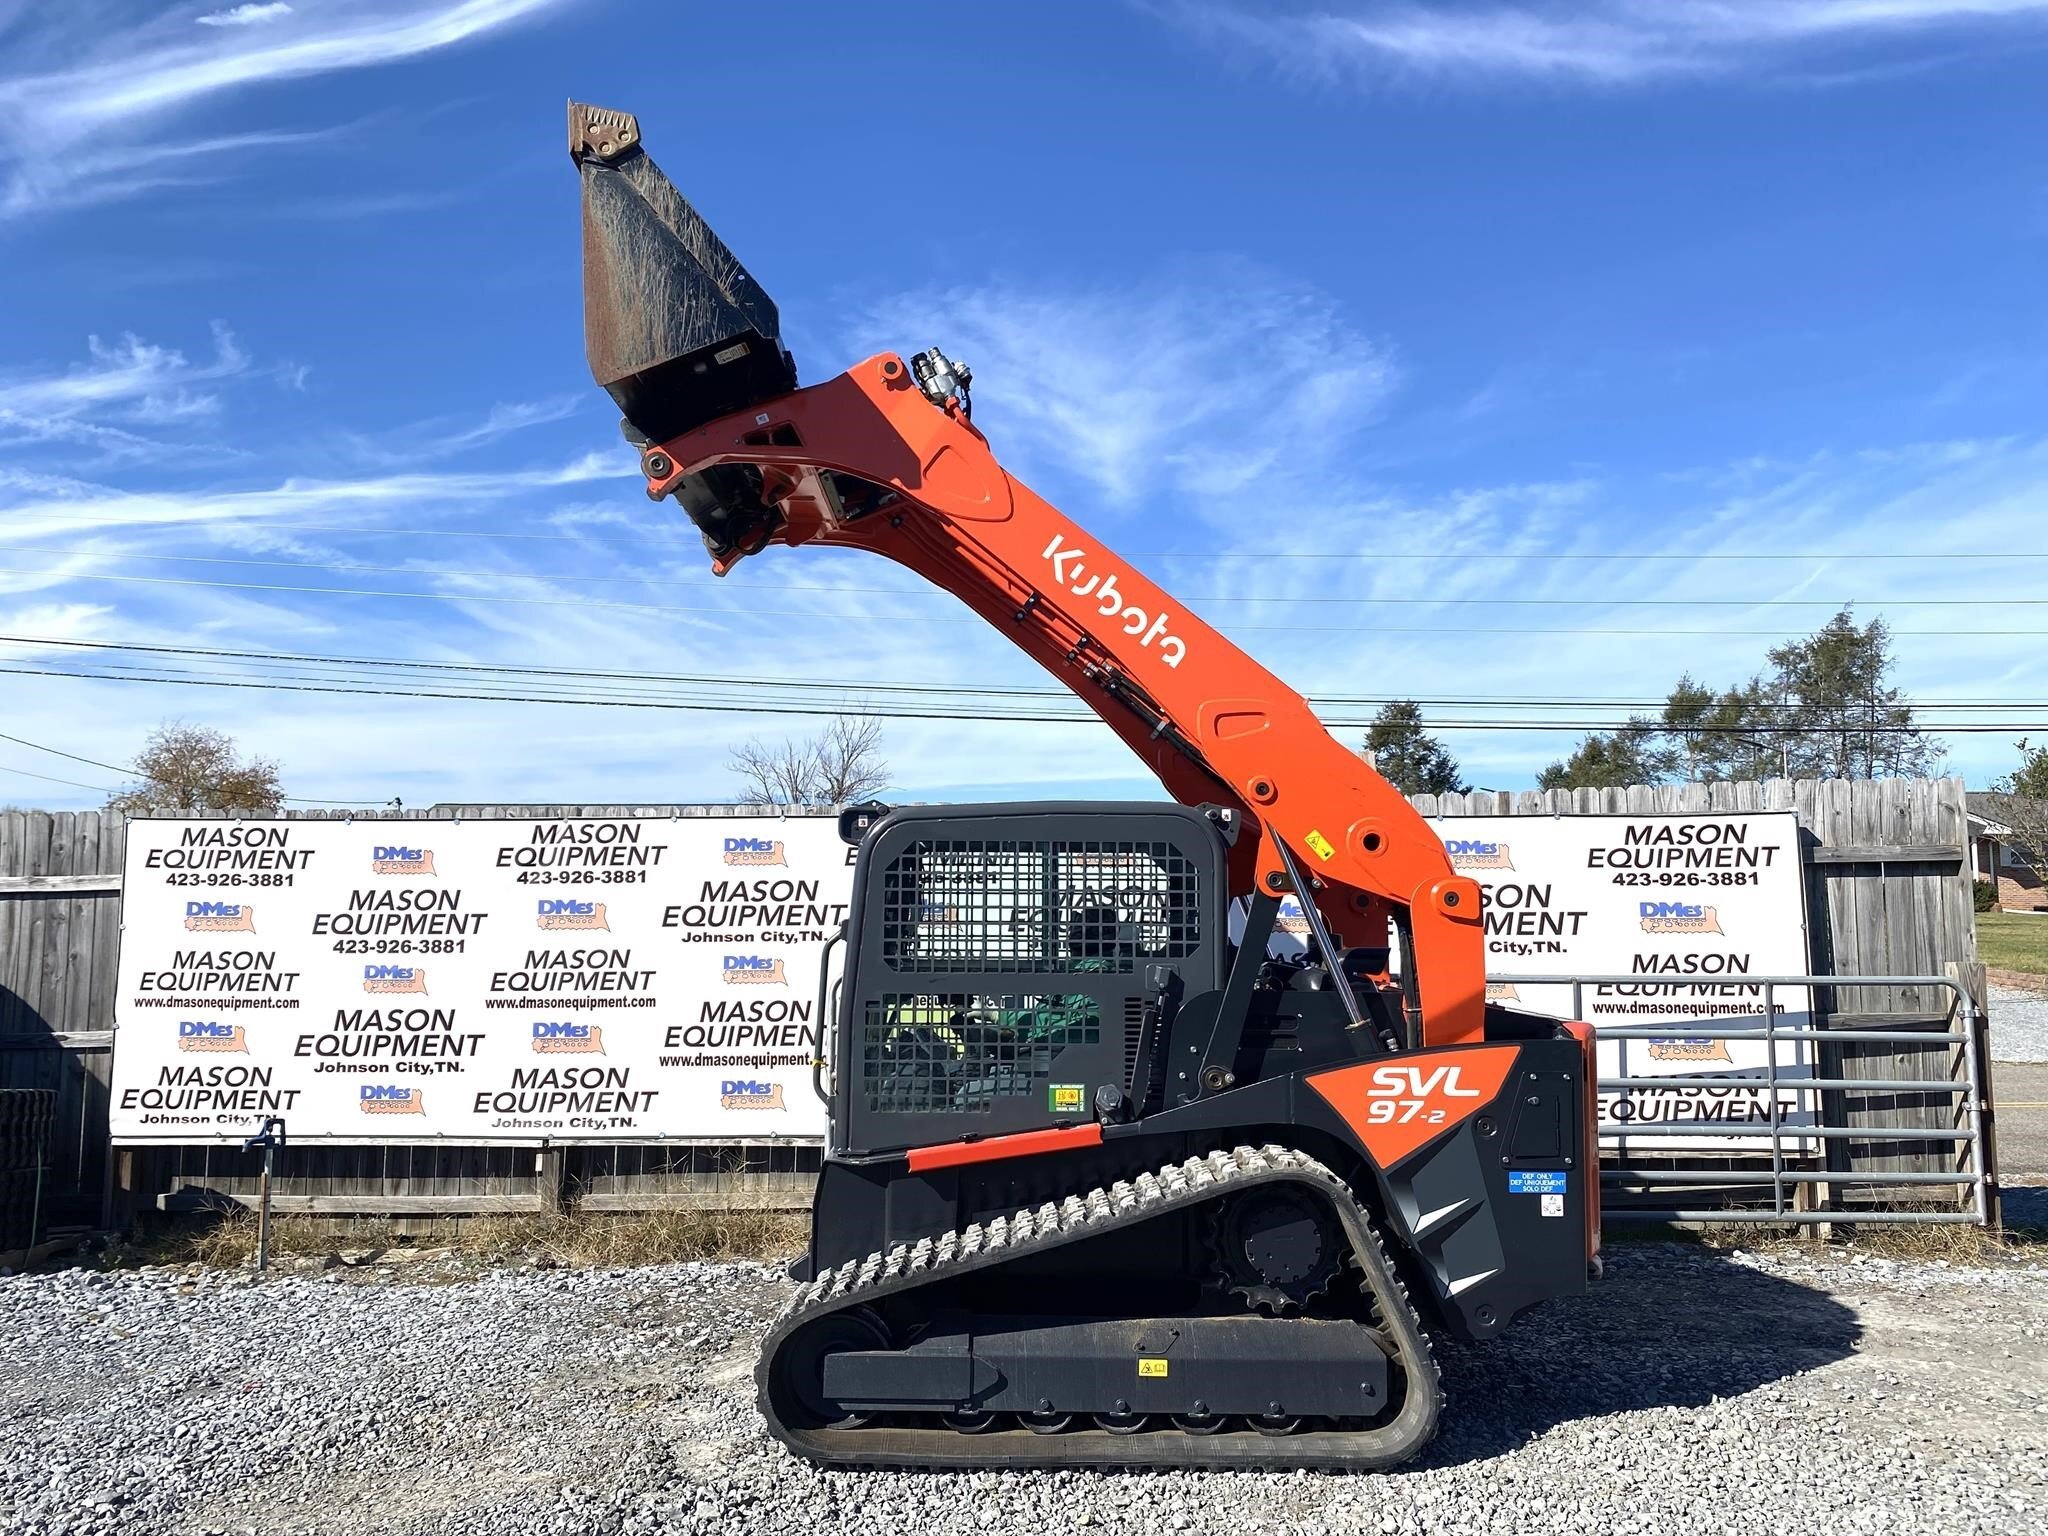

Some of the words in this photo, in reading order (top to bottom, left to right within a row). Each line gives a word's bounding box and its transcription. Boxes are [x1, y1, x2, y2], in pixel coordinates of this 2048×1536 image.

[1042, 534, 1186, 669] Kubota
[181, 827, 289, 847] MASON
[532, 822, 640, 844] MASON
[1624, 823, 1747, 846] MASON
[145, 849, 315, 869] EQUIPMENT
[496, 846, 667, 867] EQUIPMENT
[1588, 844, 1780, 868] EQUIPMENT
[166, 873, 293, 886] 423-926-3881
[517, 870, 645, 884] 423-926-3881
[1612, 872, 1758, 886] 423-926-3881
[349, 890, 461, 911] MASON
[700, 880, 819, 902] MASON
[312, 914, 488, 935] EQUIPMENT
[662, 904, 848, 928] EQUIPMENT
[333, 939, 464, 953] 423-926-3881
[681, 932, 754, 943] Johnson
[761, 931, 828, 944] City,TN.
[525, 949, 630, 969] MASON
[1489, 941, 1567, 956] City,TN.
[173, 951, 275, 970] MASON
[1633, 954, 1749, 974] MASON
[140, 972, 300, 991] EQUIPMENT
[491, 971, 656, 991] EQUIPMENT
[135, 996, 299, 1011] www.dmasonequipment.com
[486, 996, 656, 1011] www.dmasonequipment.com
[700, 1000, 811, 1022] MASON
[334, 1009, 455, 1032] MASON
[294, 1034, 485, 1057] EQUIPMENT
[664, 1026, 817, 1048] EQUIPMEN
[158, 1066, 272, 1087] MASON
[314, 1062, 389, 1072] Johnson
[396, 1062, 464, 1075] City,TN.
[511, 1068, 629, 1089] MASON
[1367, 1067, 1480, 1097] SVL
[120, 1089, 301, 1110] EQUIPMENT
[474, 1091, 659, 1113] EQUIPMENT
[139, 1114, 210, 1124] Johnson
[1367, 1100, 1446, 1124] 97-2
[492, 1118, 563, 1127] Johnson
[570, 1117, 637, 1130] City,TN.
